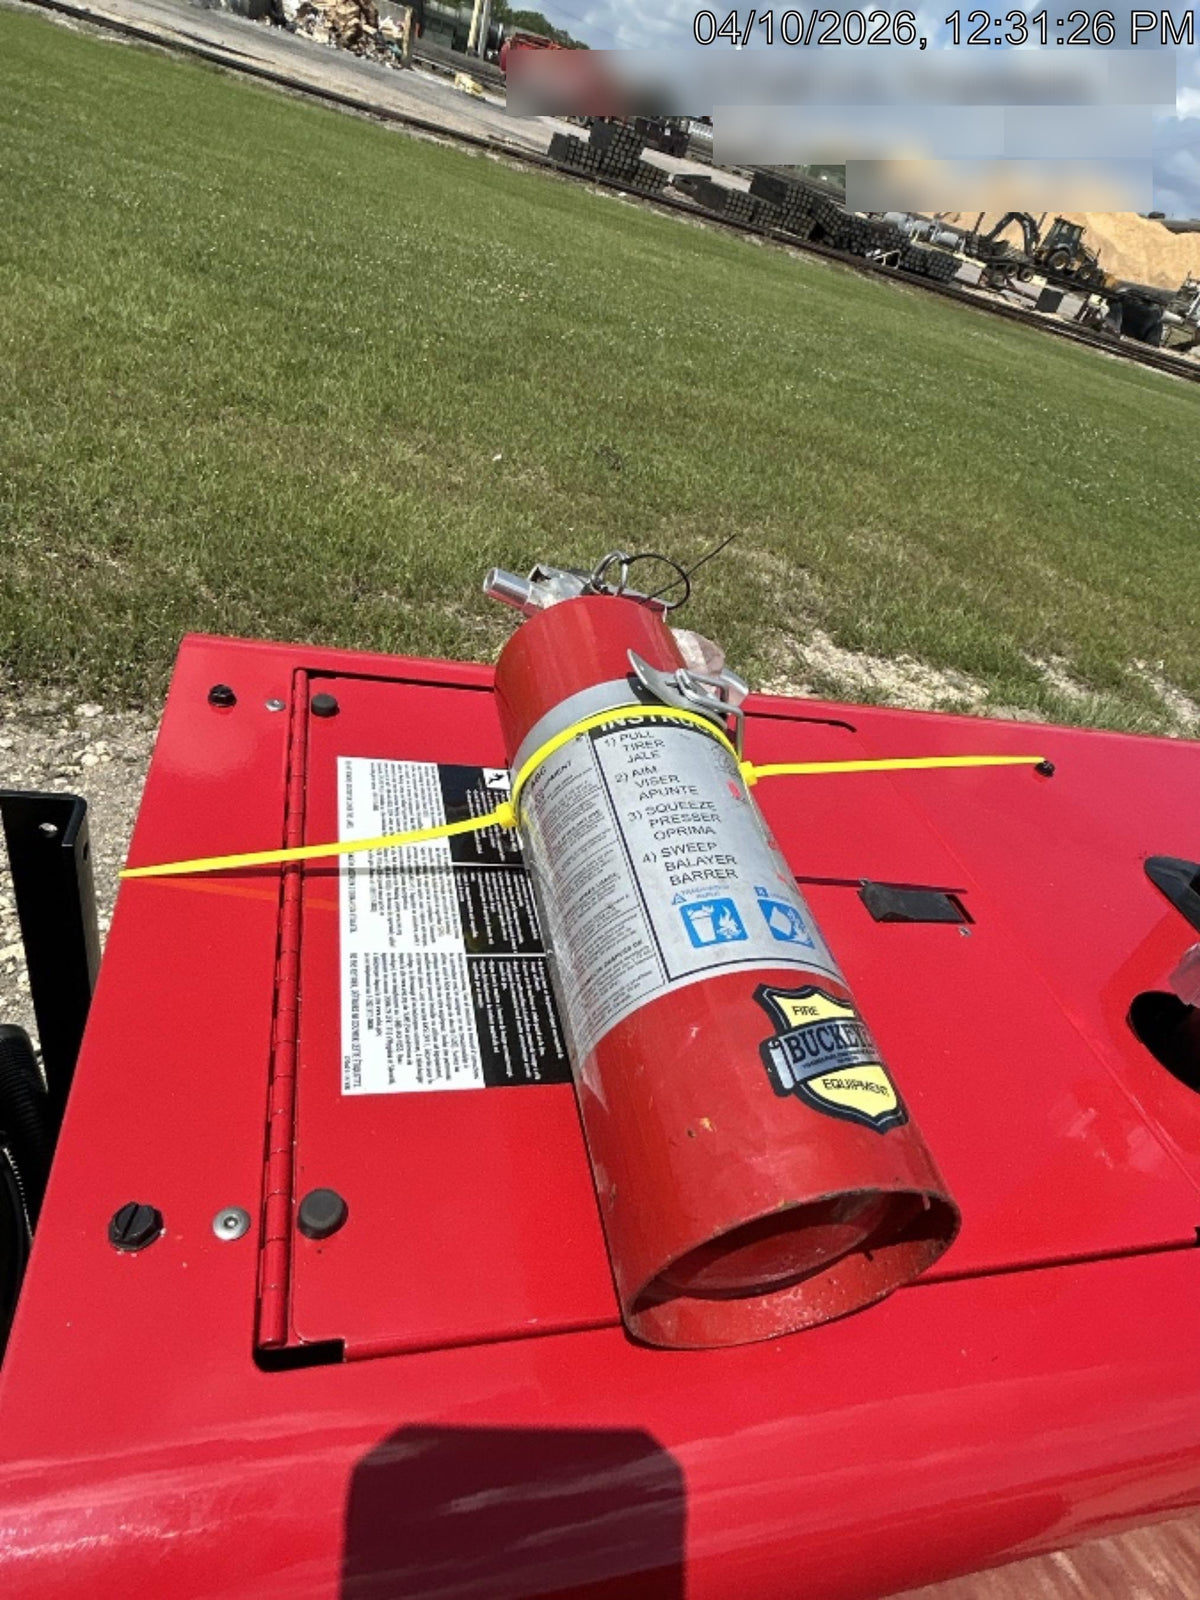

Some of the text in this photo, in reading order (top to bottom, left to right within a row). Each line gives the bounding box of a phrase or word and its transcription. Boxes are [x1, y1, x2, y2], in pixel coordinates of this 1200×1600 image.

[604, 730, 655, 747] 1) PULL
[623, 739, 666, 752] TIRER
[627, 750, 662, 764] JALE
[614, 765, 657, 784] 2) AIM
[634, 775, 680, 789] VISER
[639, 785, 698, 801] APUNTE
[627, 801, 718, 823] 3) SQUEEZE
[650, 813, 722, 829] PRESSER
[653, 826, 717, 841] OPRIMA
[642, 842, 717, 864] 4) SWEEP
[664, 854, 738, 872] BALAYER
[669, 868, 739, 886] BARRER
[792, 1006, 820, 1016] FIRE
[822, 1078, 890, 1097] EQUIPMENT
